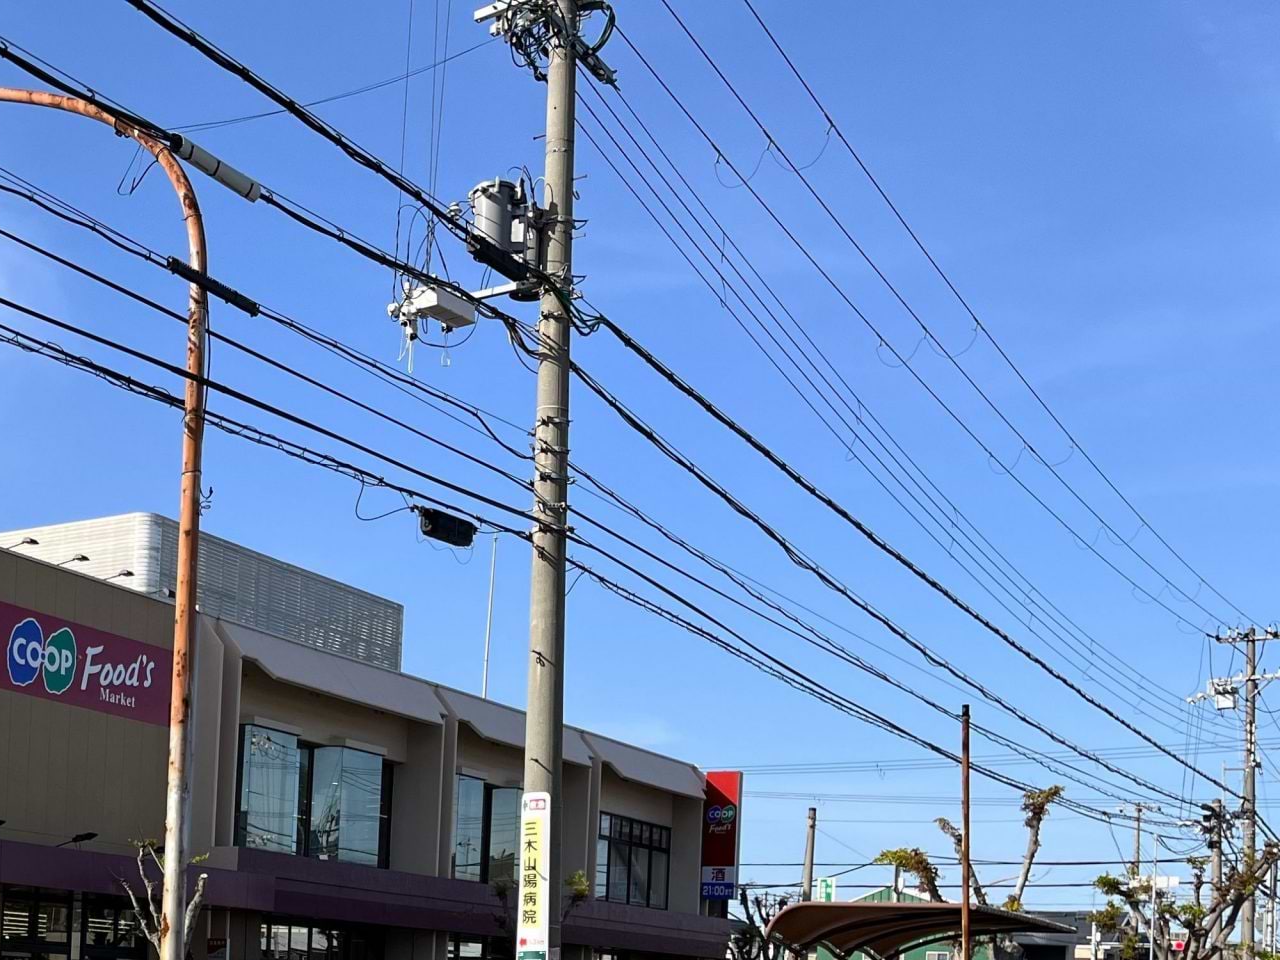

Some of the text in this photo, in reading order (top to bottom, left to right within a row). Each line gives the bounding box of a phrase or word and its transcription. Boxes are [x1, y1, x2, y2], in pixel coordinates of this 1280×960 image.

[80, 645, 156, 691] Food's
[99, 687, 137, 708] Market
[522, 821, 537, 924] 三木山陽病院
[711, 868, 726, 882] 酒
